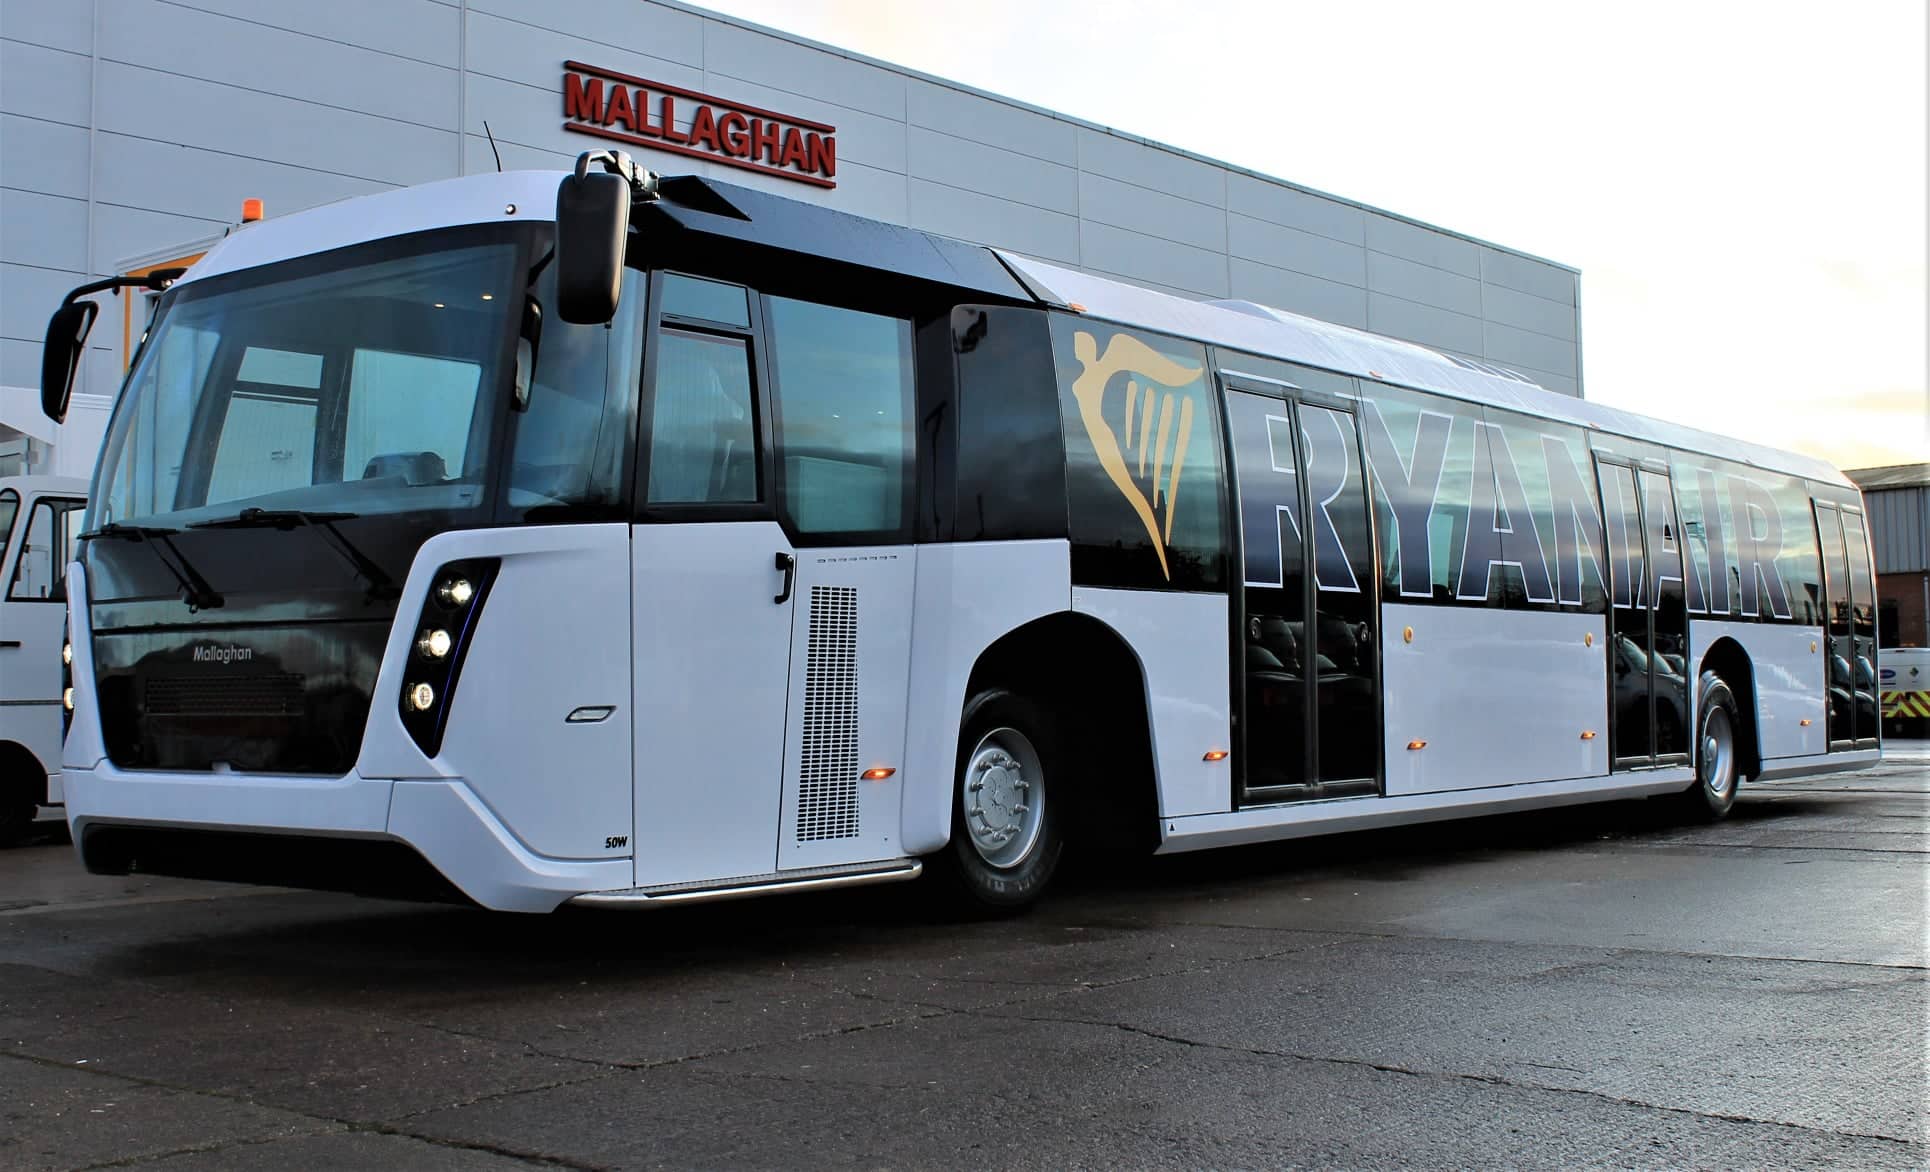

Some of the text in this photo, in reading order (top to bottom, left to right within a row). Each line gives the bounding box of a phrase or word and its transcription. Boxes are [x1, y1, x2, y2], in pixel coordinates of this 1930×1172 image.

[564, 72, 836, 178] MALLAGHAN
[1219, 368, 1793, 620] RYANAIR
[193, 644, 252, 664] Mallaghan
[605, 835, 628, 849] 50W
